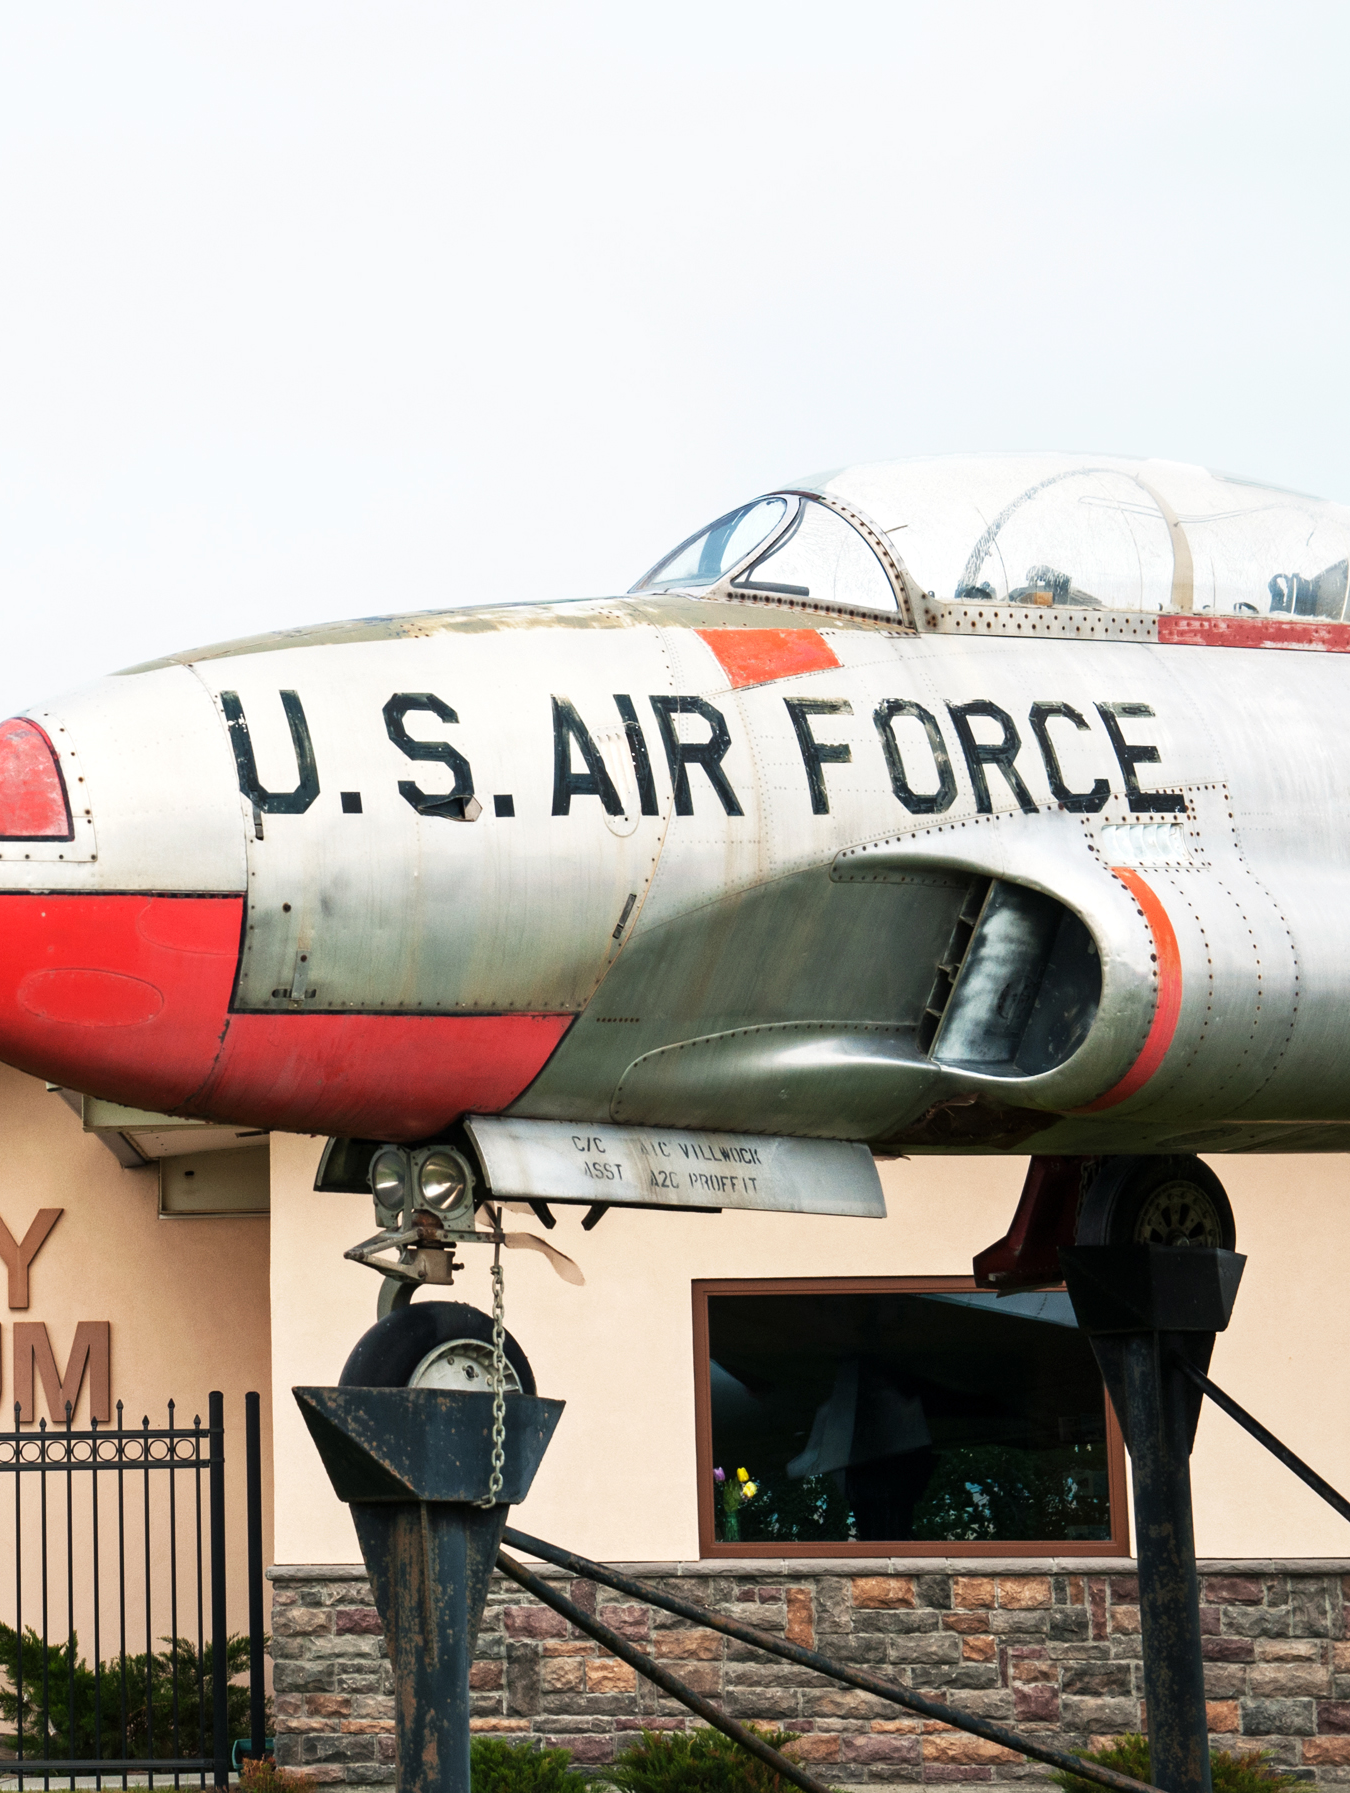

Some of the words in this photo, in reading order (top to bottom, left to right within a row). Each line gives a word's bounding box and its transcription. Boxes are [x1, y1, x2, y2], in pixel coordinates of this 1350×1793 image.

[220, 689, 516, 820] U.S.
[550, 693, 745, 817] AIR
[783, 697, 1187, 815] FORCE
[678, 1142, 762, 1165] VILLWOCK
[584, 1161, 623, 1181] ASST
[688, 1172, 757, 1194] PROFFIT
